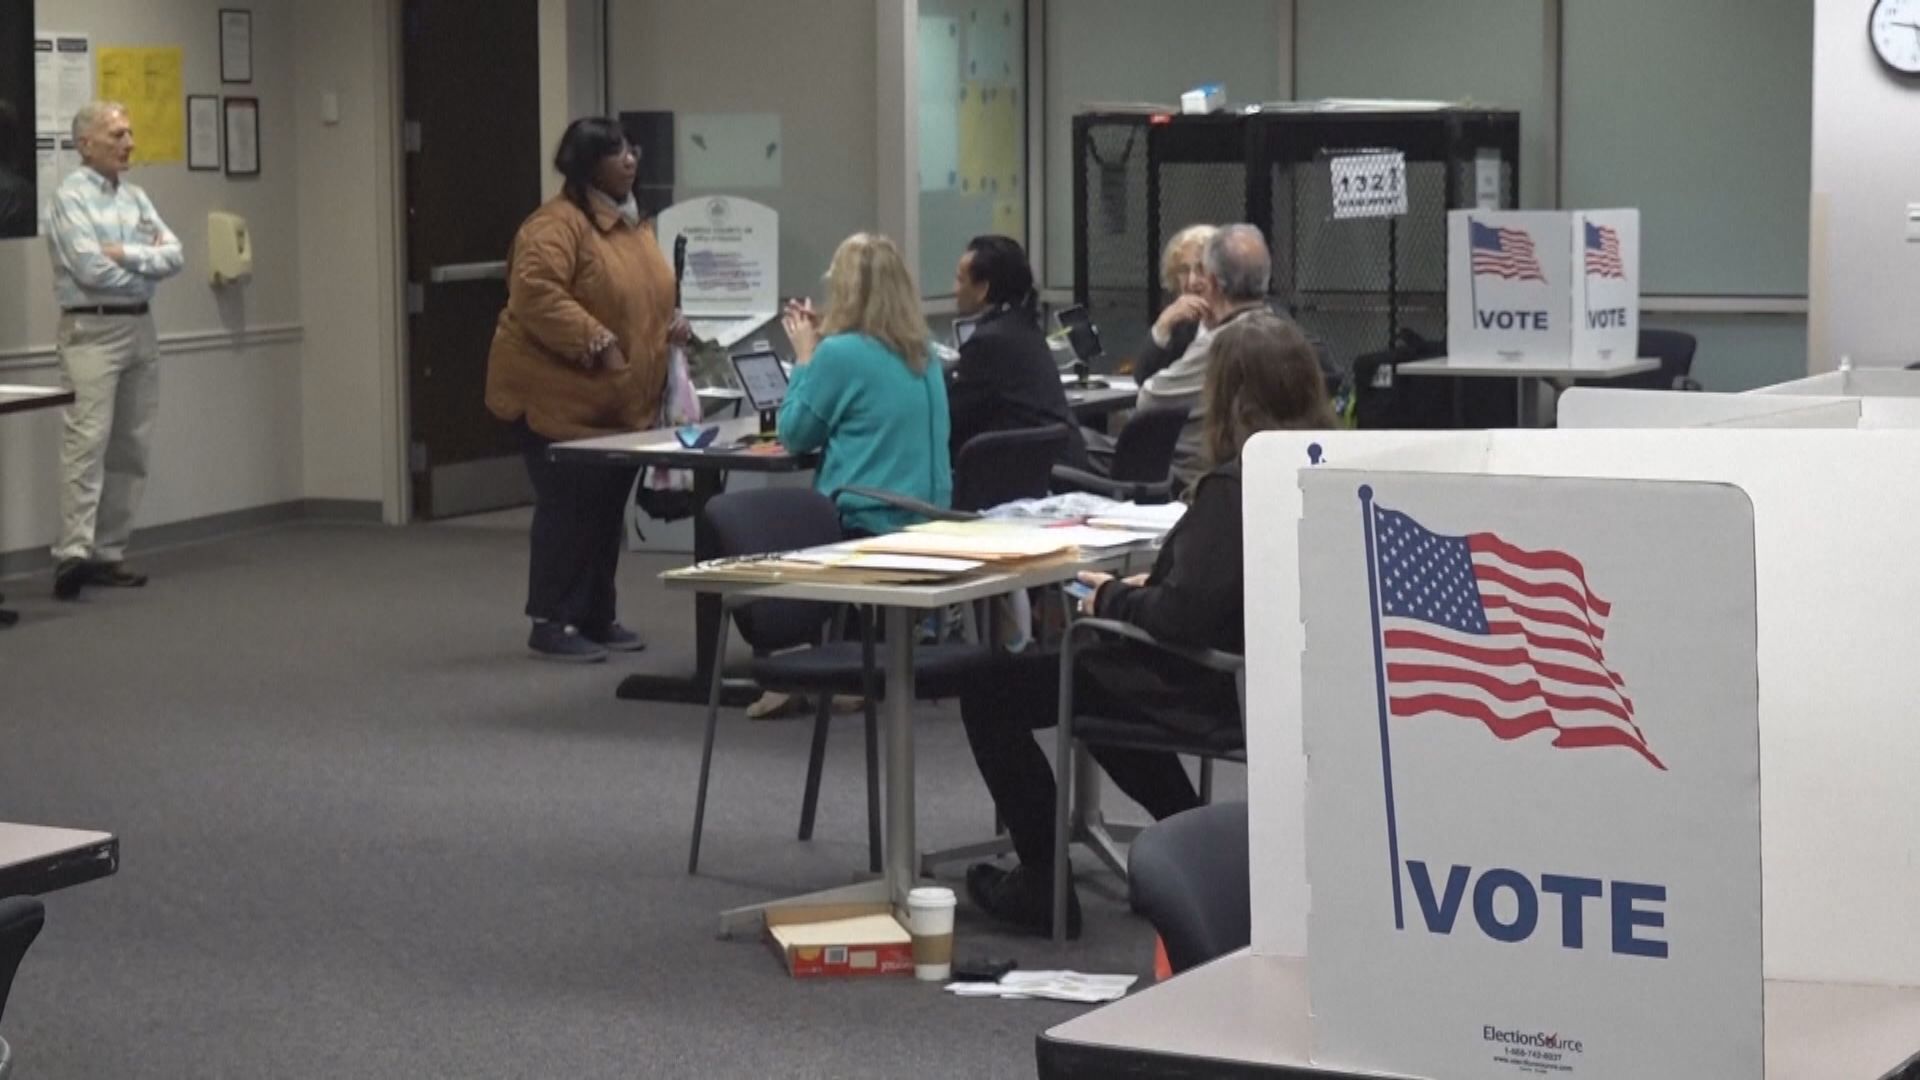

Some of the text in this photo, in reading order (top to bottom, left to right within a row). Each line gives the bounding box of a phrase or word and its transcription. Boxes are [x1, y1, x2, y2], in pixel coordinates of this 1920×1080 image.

[1479, 309, 1549, 330] VOTE
[1588, 307, 1626, 330] VOTE
[1405, 860, 1668, 958] VOTE
[1483, 1025, 1583, 1053] ElectionSource
